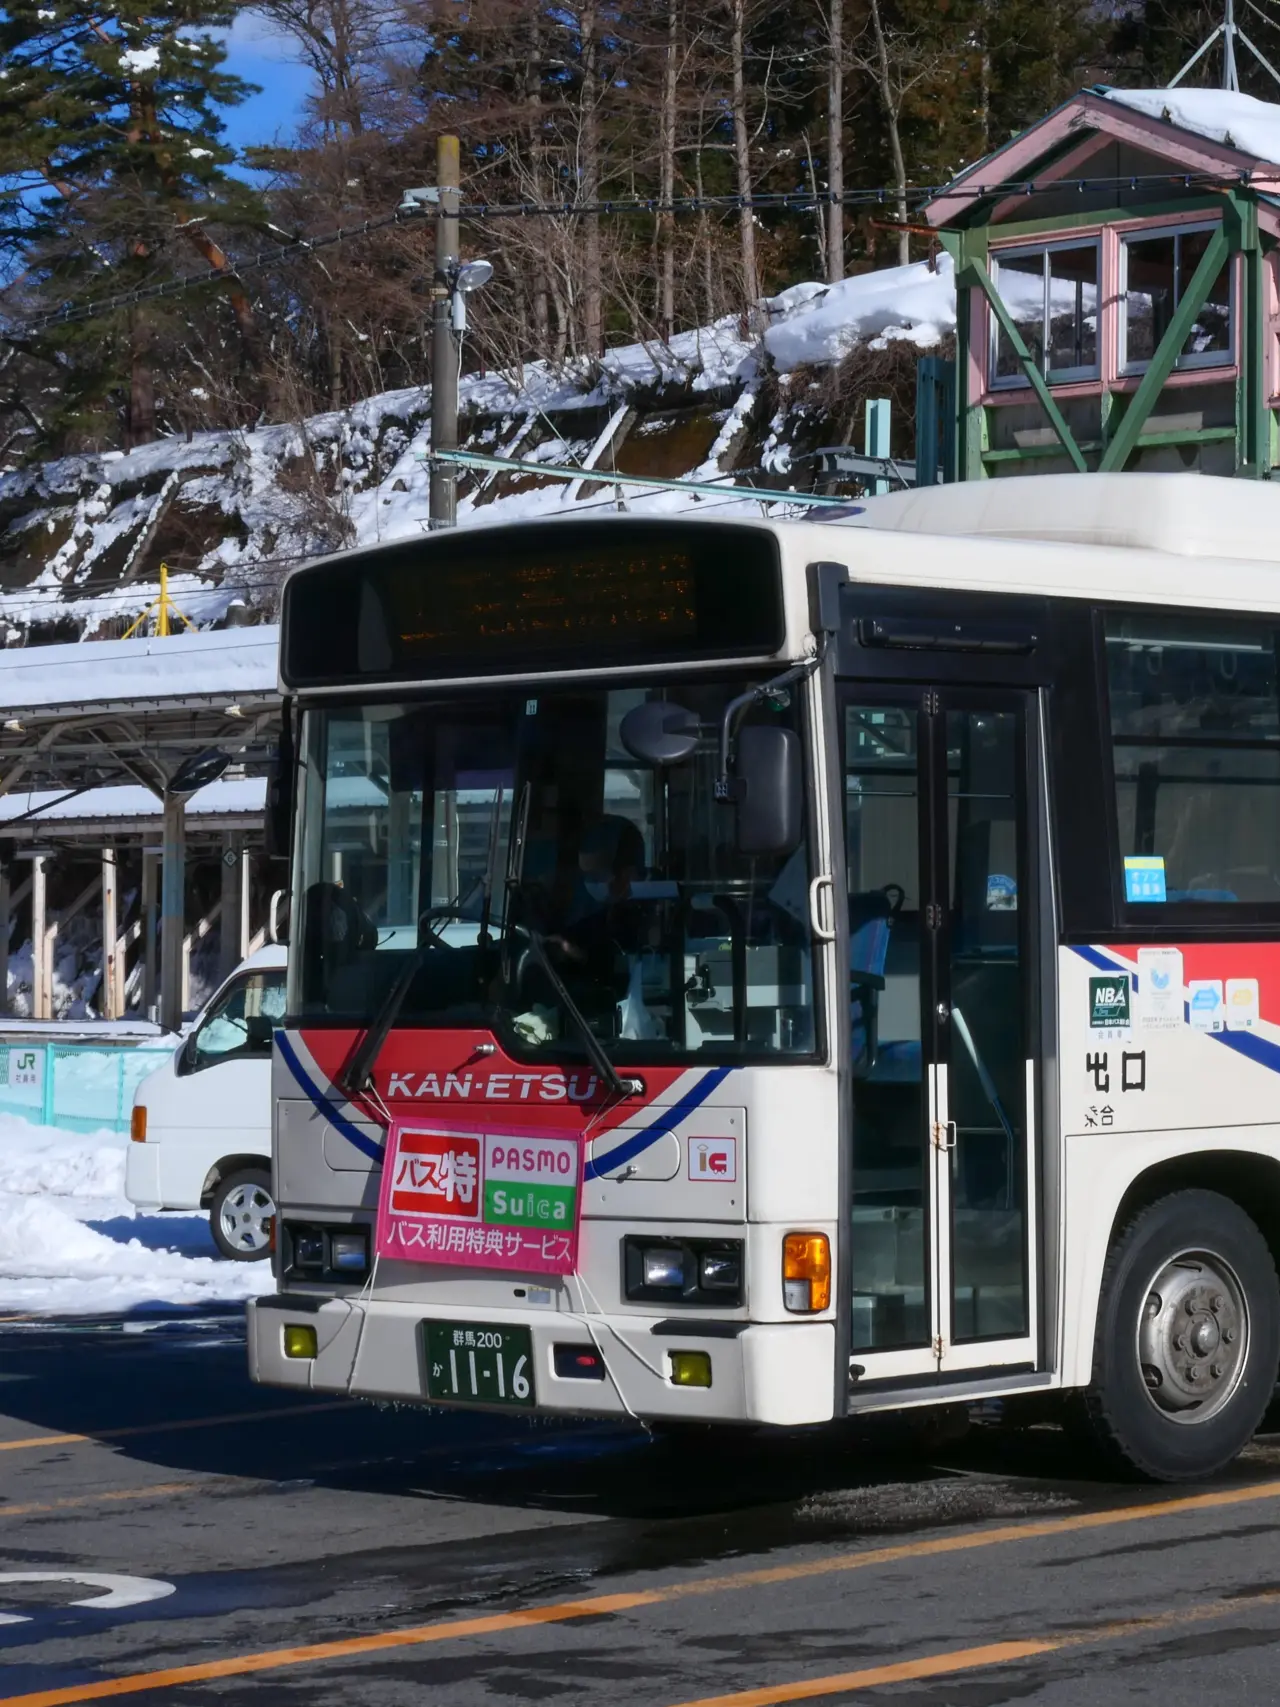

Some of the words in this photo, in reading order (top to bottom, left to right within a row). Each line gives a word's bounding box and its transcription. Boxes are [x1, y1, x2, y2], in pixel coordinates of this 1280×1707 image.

[1095, 987, 1126, 1004] NBA
[17, 1053, 36, 1070] JR
[491, 1147, 571, 1174] PASMO
[493, 1190, 566, 1220] Suica
[386, 1221, 573, 1262] バス利用特典サービス
[432, 1362, 444, 1378] か
